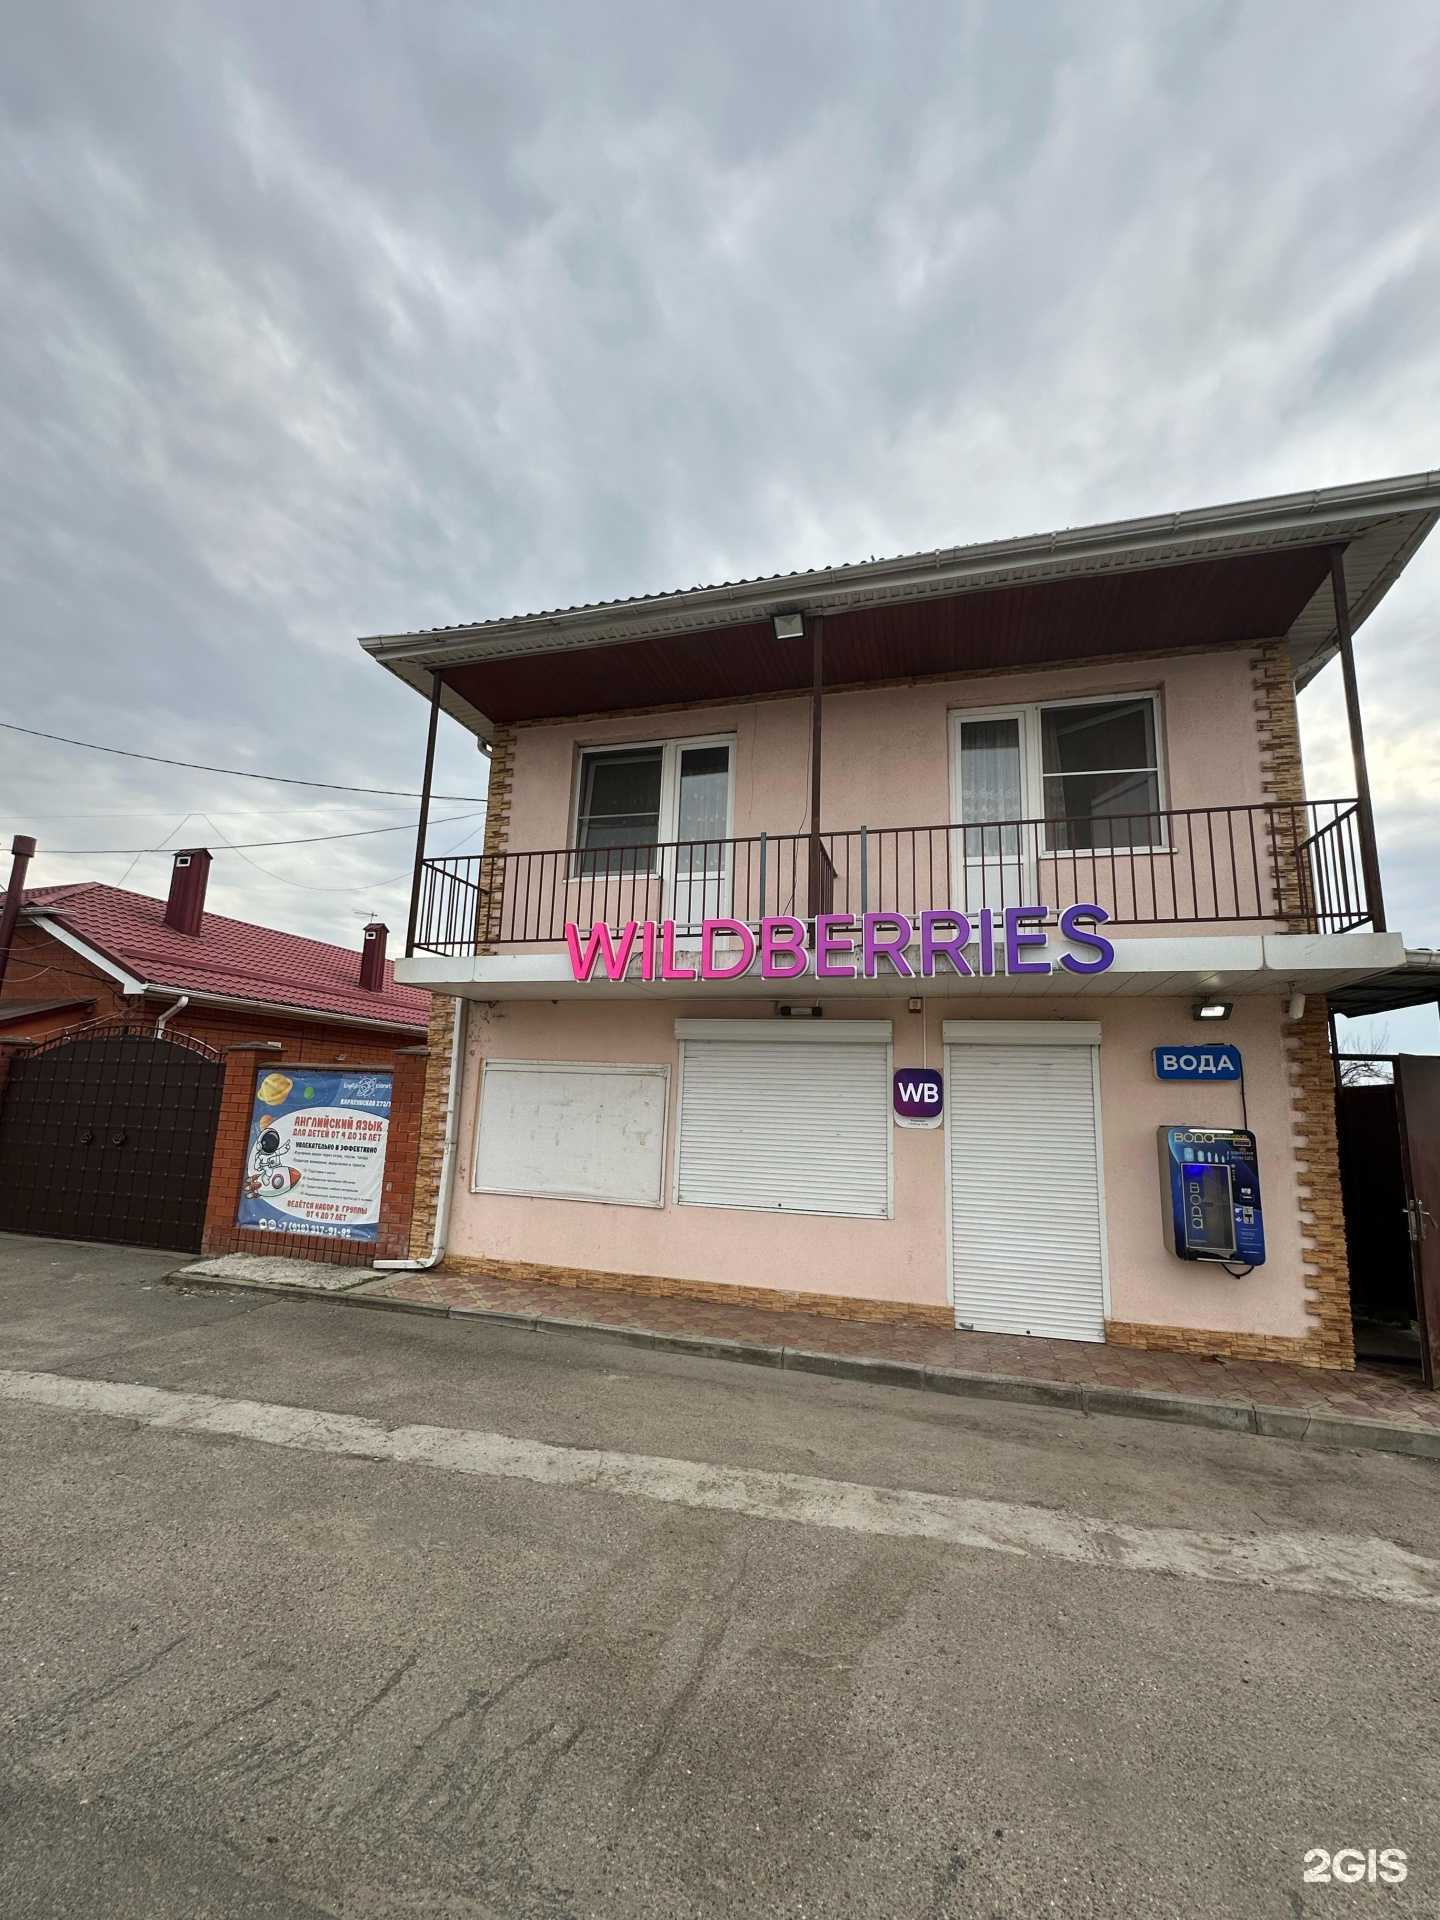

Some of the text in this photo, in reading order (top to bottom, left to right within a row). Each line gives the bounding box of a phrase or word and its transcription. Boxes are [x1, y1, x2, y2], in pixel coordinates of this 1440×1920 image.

[565, 903, 1116, 982] WILDBERRIES
[1163, 1054, 1235, 1073] ВОДА
[898, 1082, 939, 1103] WB
[294, 1115, 384, 1132] АНГЛИЙСКИЙ ЯЗЫК
[292, 1128, 306, 1136] ДЛЯ
[307, 1129, 330, 1138] ДЕТЕЙ
[331, 1131, 341, 1139] ОТ
[347, 1132, 357, 1140] ДО
[368, 1133, 382, 1142] ЛЕТ
[295, 1142, 335, 1151] УВЛЕКАТЕЛЬНО
[340, 1145, 378, 1154] ЭФФЕКТИВНО
[305, 1210, 314, 1218] ОТ
